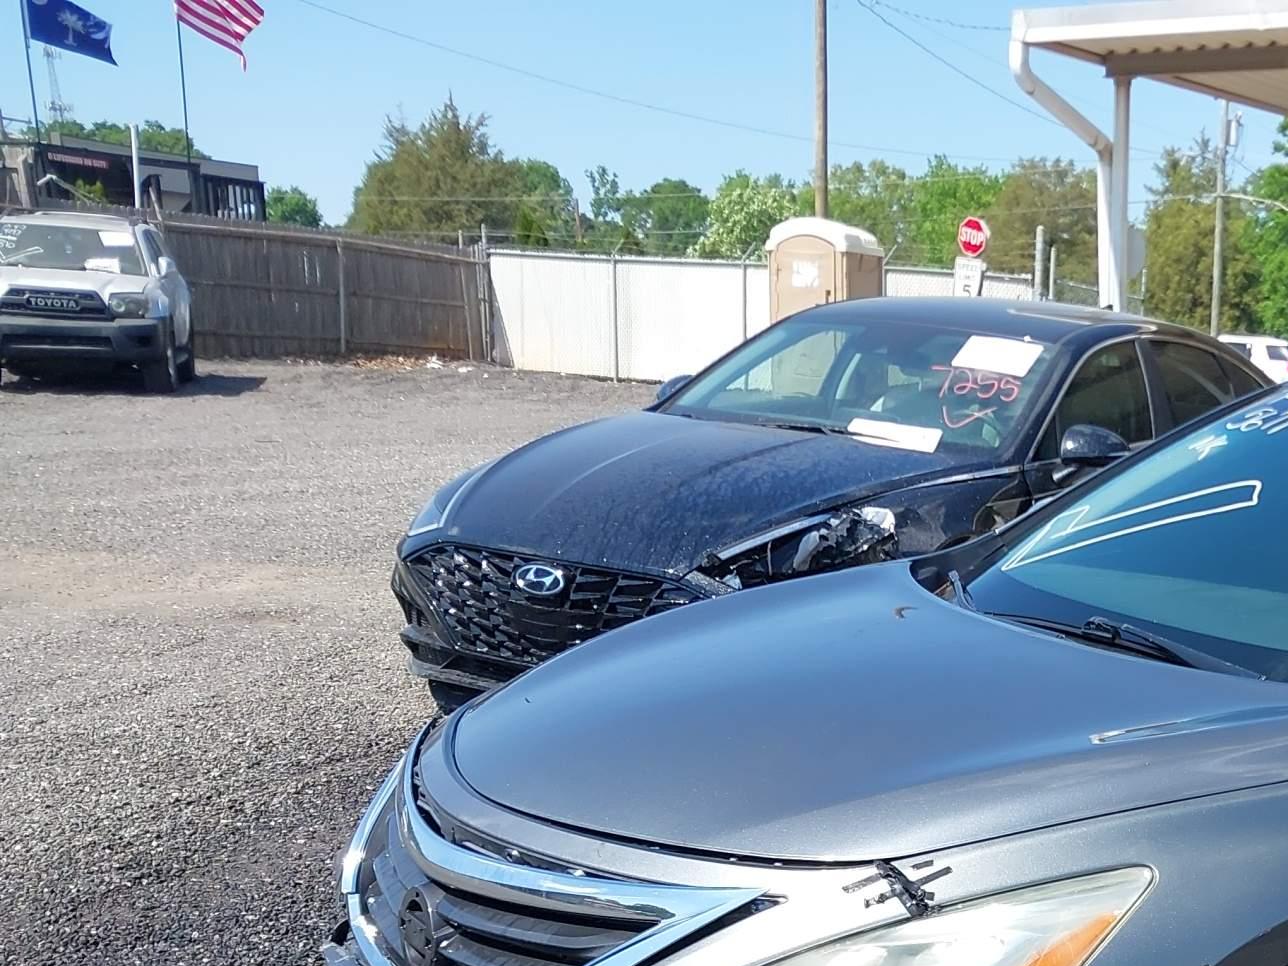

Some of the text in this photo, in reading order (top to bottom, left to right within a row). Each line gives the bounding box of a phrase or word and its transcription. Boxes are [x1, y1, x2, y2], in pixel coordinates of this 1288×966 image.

[960, 226, 984, 246] STOP
[28, 298, 76, 308] TOYOTA
[931, 365, 1022, 402] 7255
